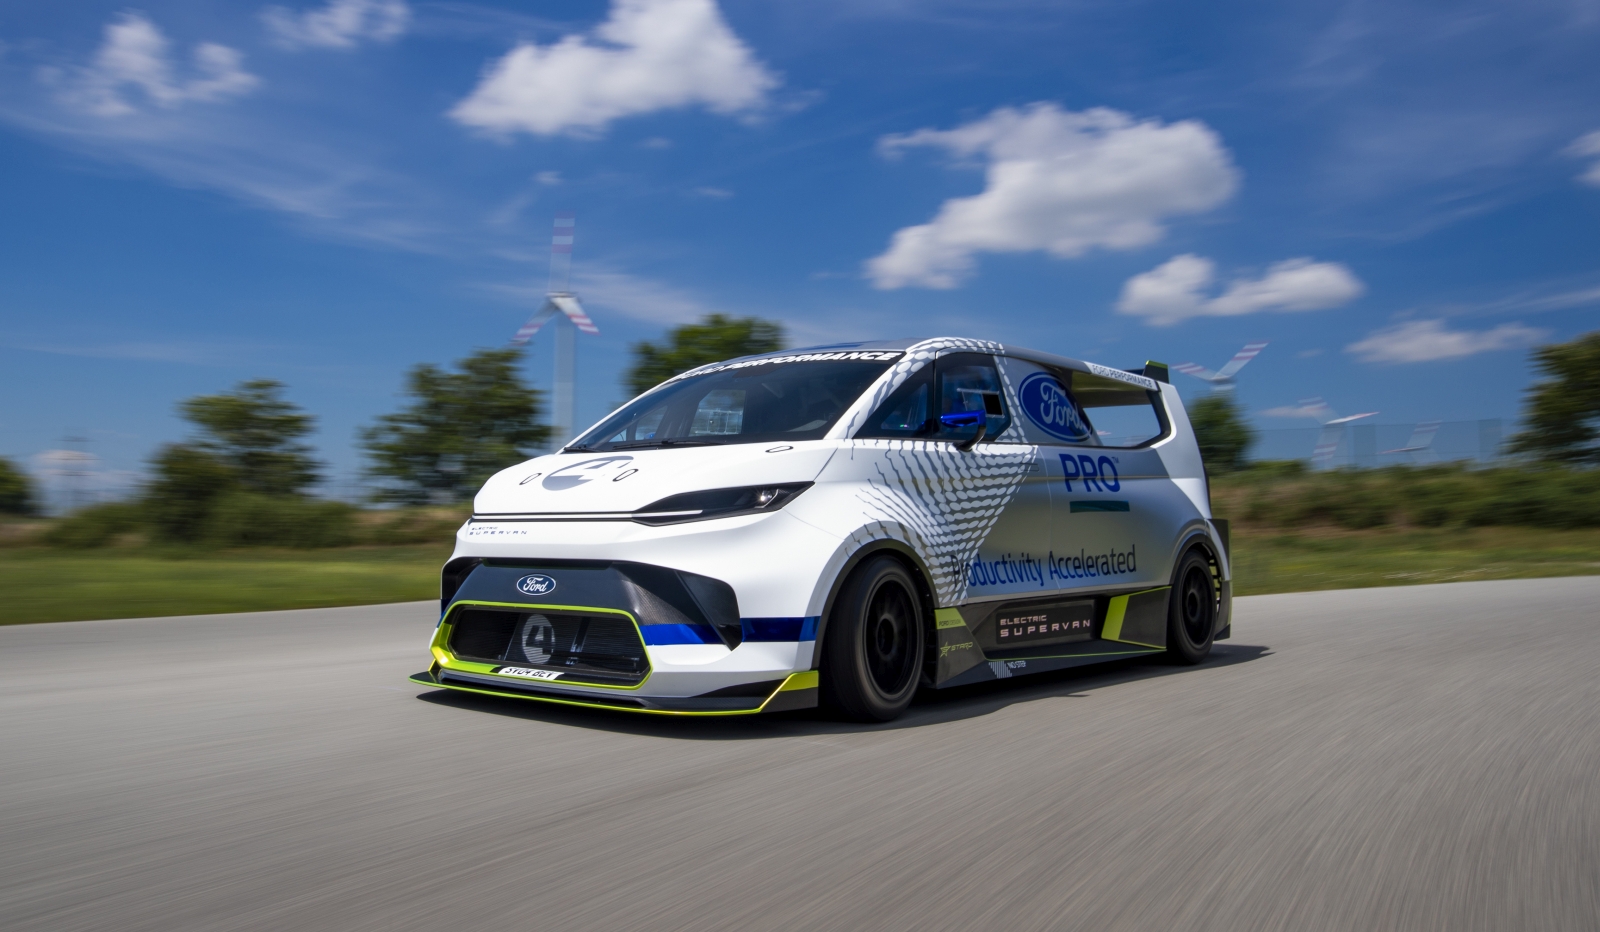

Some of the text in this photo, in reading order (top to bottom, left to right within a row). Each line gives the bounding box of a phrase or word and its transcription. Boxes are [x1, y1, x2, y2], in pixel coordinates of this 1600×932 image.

[1092, 364, 1153, 388] FORD PERFORMANCE
[1040, 381, 1087, 430] Ford
[950, 544, 1137, 587] Productivity Accelerated
[522, 576, 549, 592] Ford
[1000, 614, 1047, 626] ELECTRIC
[1000, 619, 1091, 638] SUPERVAN
